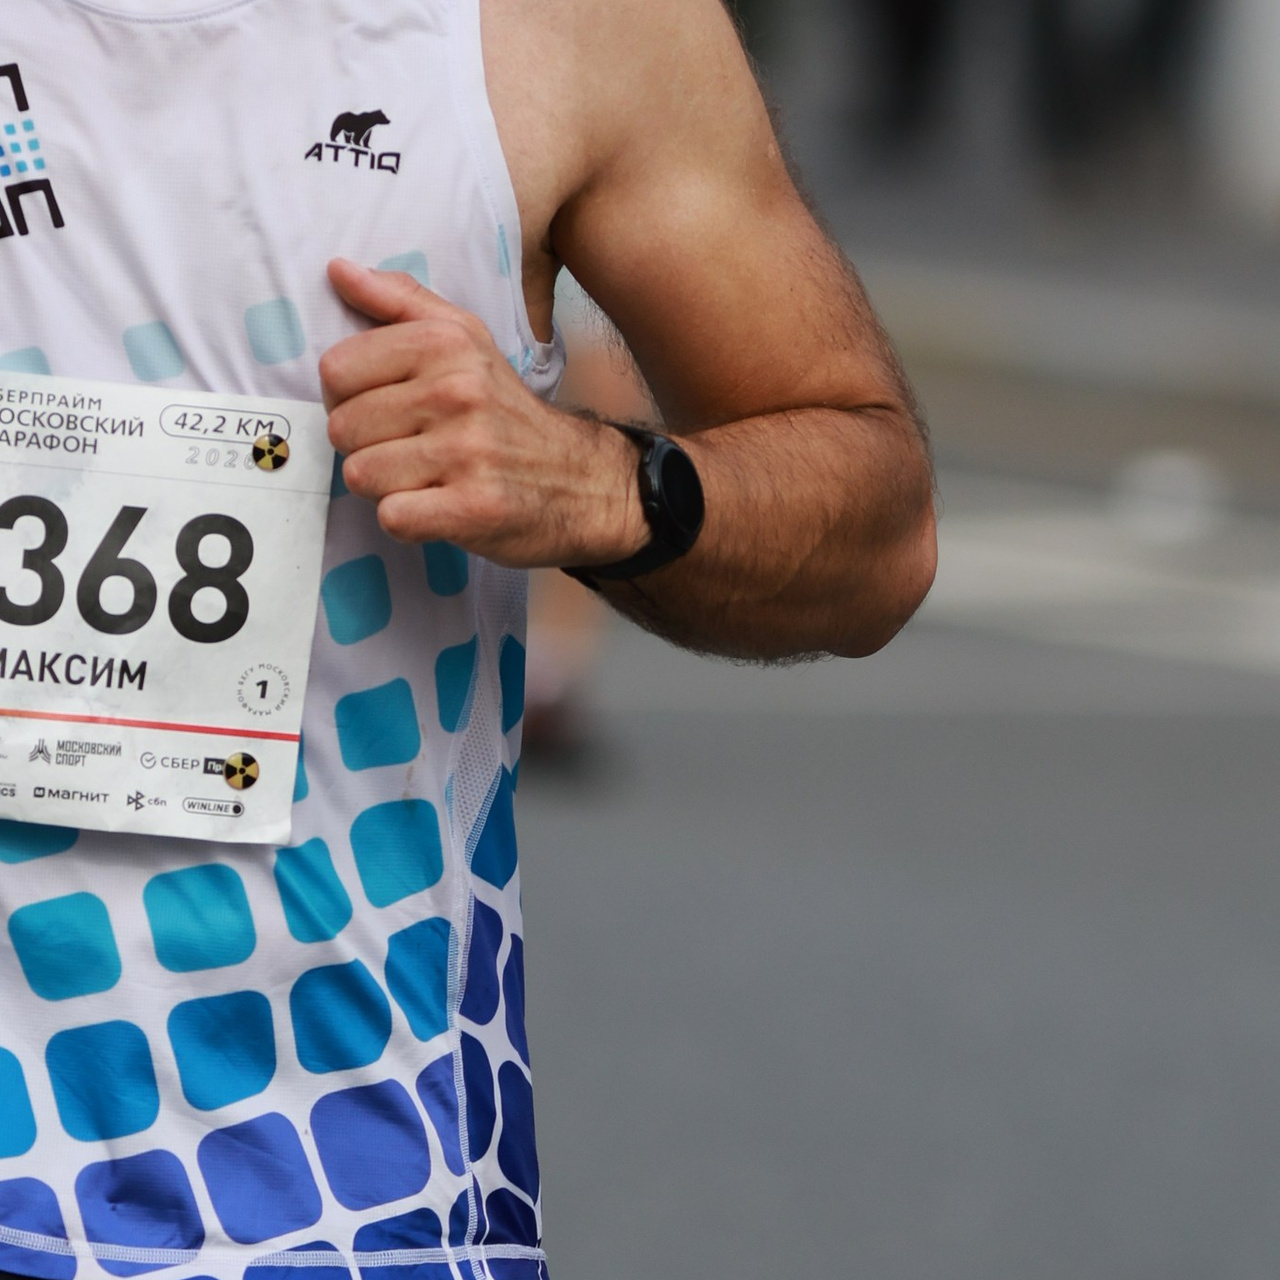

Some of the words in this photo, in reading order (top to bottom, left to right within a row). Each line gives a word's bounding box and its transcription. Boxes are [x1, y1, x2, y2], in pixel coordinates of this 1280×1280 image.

[304, 142, 401, 175] ATTIQ
[174, 412, 227, 435] 42,2
[256, 680, 268, 699] 1
[56, 739, 122, 757] МОСКОВСКИЙ
[55, 752, 86, 767] СПОРТ
[160, 756, 200, 771] СБЕР
[47, 788, 110, 803] магнит
[187, 801, 230, 813] WINLINE
